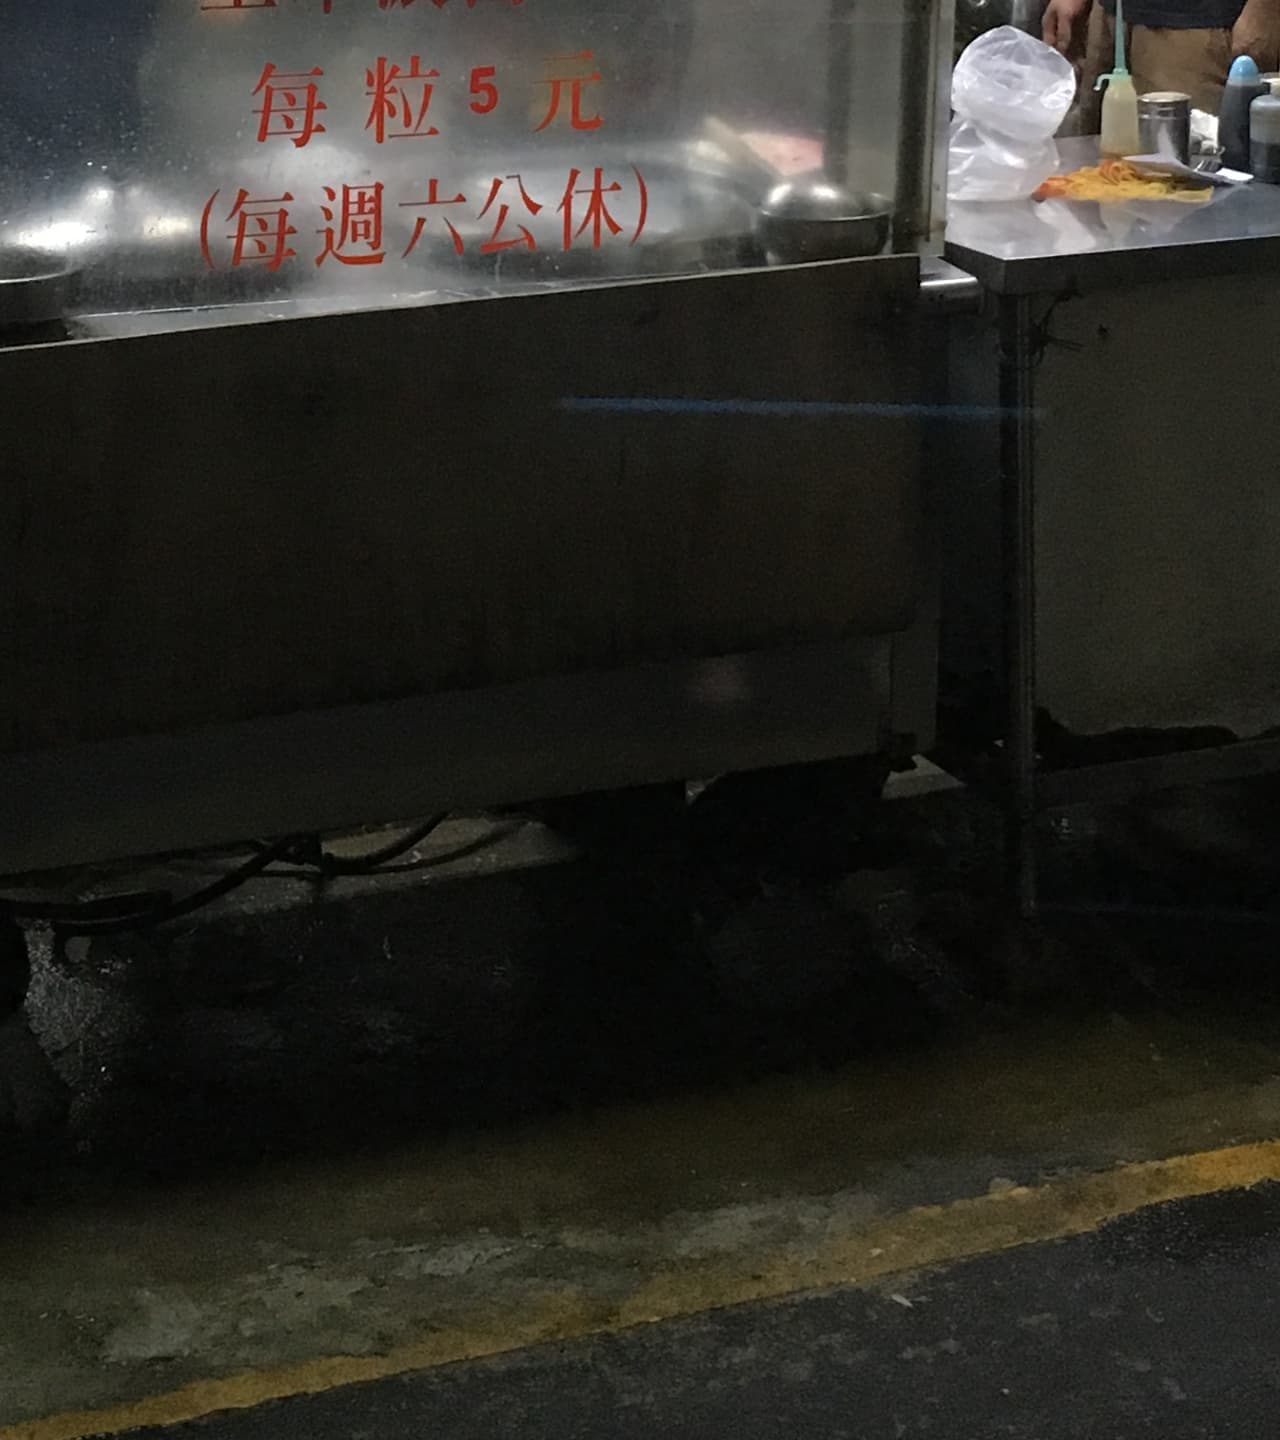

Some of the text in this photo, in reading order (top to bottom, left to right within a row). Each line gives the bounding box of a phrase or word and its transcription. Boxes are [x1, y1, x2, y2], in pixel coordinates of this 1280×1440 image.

[250, 49, 605, 149] 每粒5元
[199, 165, 649, 273] (每週六公休)
